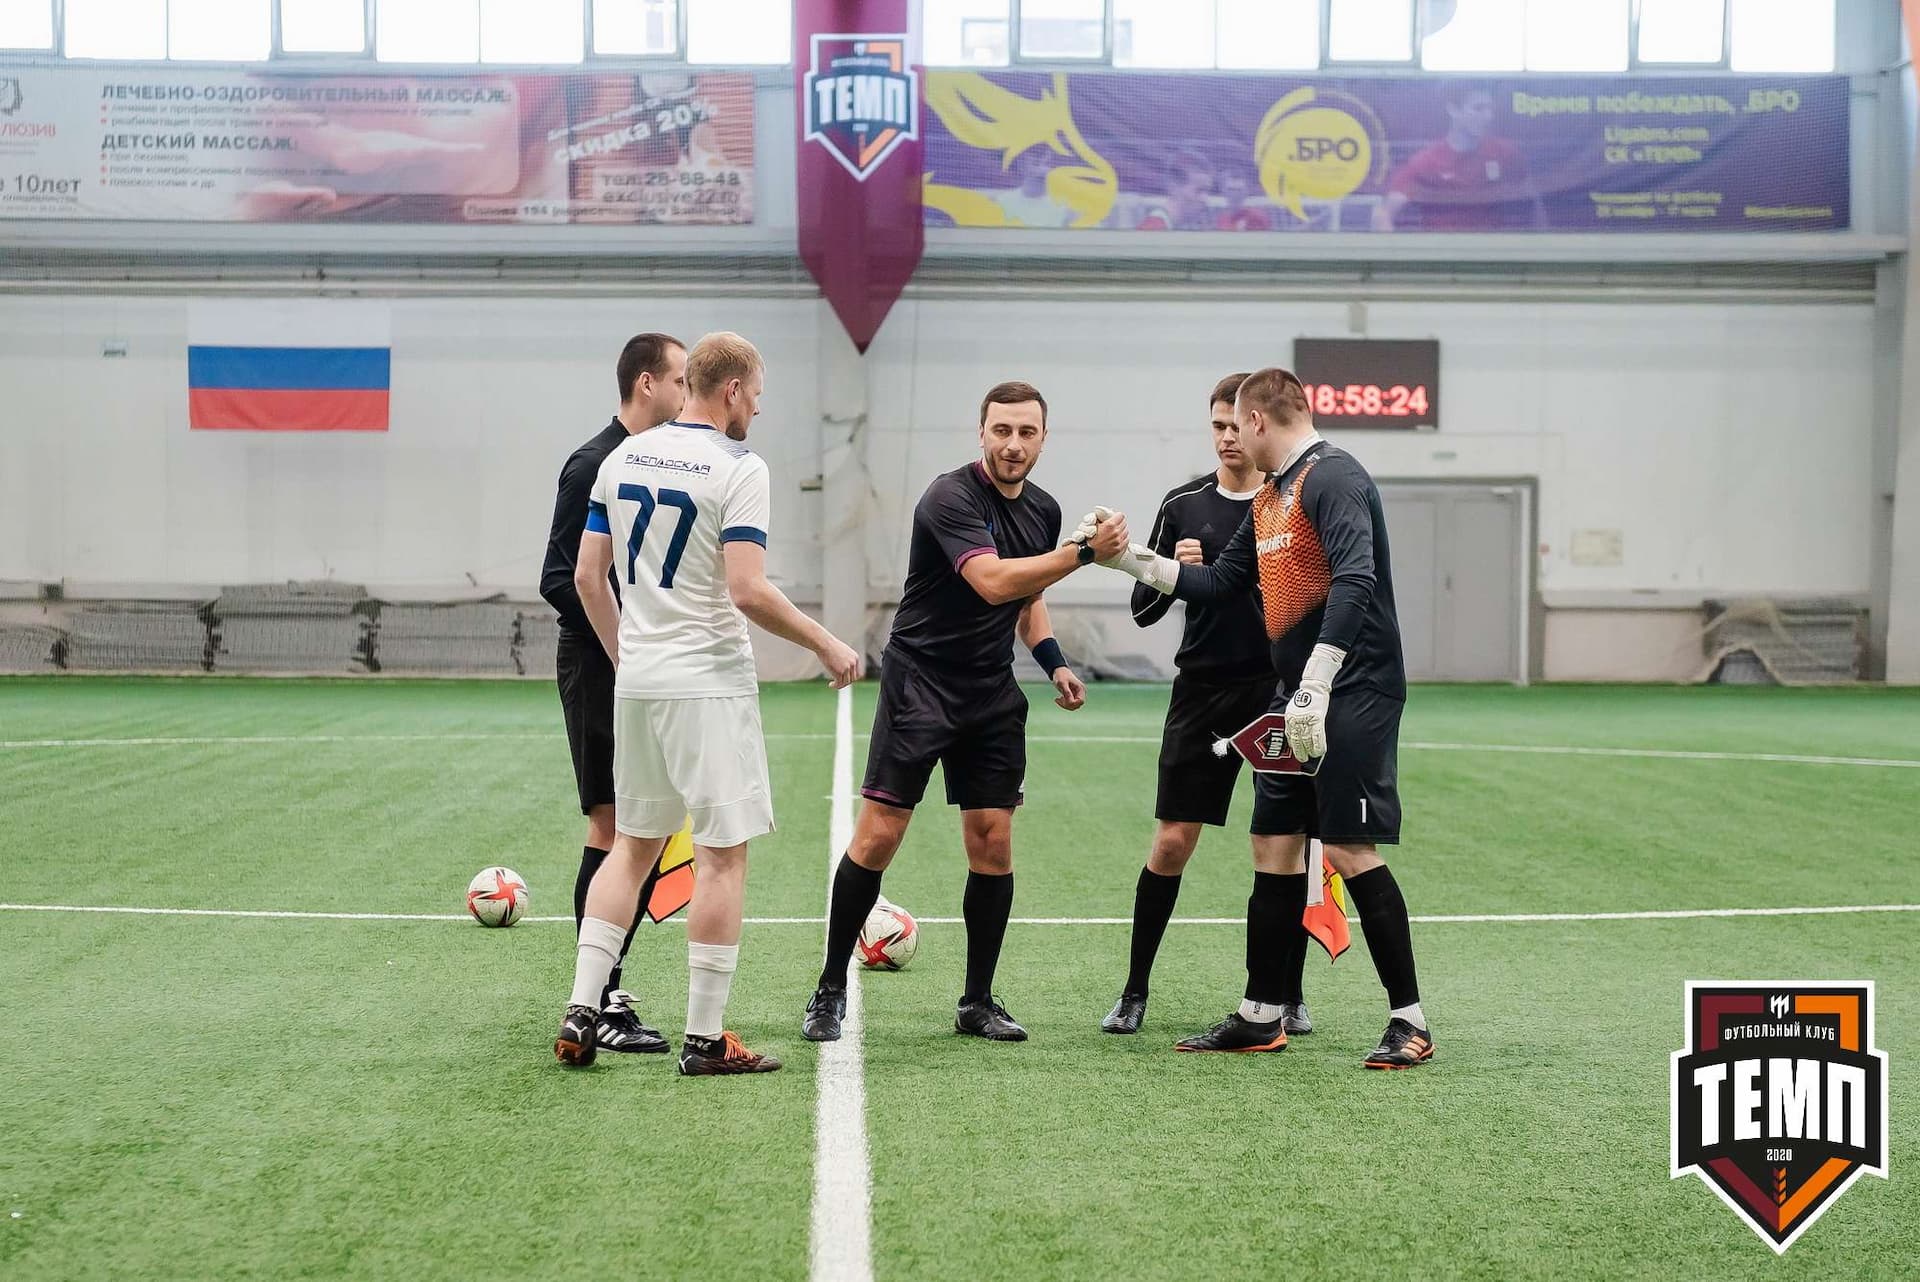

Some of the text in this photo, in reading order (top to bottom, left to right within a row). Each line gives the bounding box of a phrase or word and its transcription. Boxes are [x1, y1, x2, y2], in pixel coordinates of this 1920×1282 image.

[102, 85, 408, 102] ЛЕЧЕБНО-ОЗДОРОВИТЕЛЬНЫЙ
[815, 75, 907, 124] ТЕМП
[101, 132, 196, 150] ДЕТСКИЙ
[1303, 384, 1429, 416] 18:58:24
[617, 482, 698, 589] 77
[1360, 798, 1367, 823] 1
